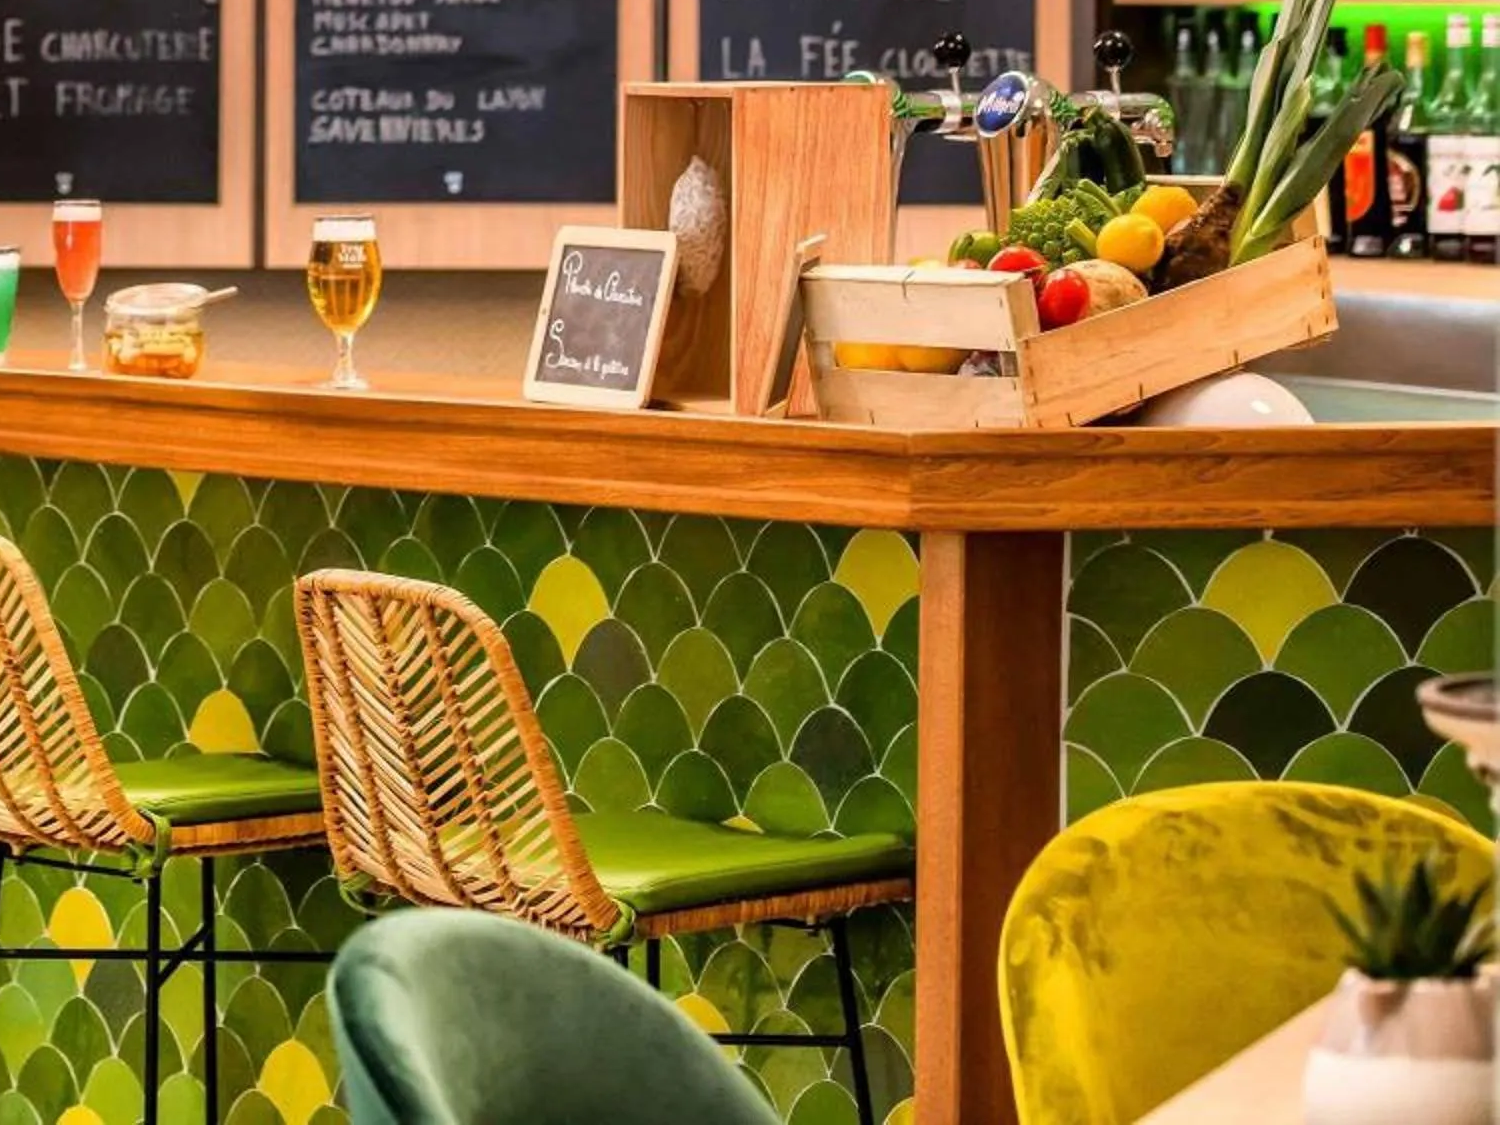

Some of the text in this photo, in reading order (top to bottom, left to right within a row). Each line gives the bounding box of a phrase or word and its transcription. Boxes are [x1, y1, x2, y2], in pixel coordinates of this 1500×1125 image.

[312, 10, 431, 33] MUSCADET
[40, 26, 214, 63] CHARCUTERIE
[310, 35, 464, 57] CHARDONNAY
[720, 36, 767, 80] LA
[799, 19, 860, 78] FÉE
[55, 80, 196, 117] FROMAGE
[425, 88, 456, 112] DU
[477, 85, 547, 112] LAYON
